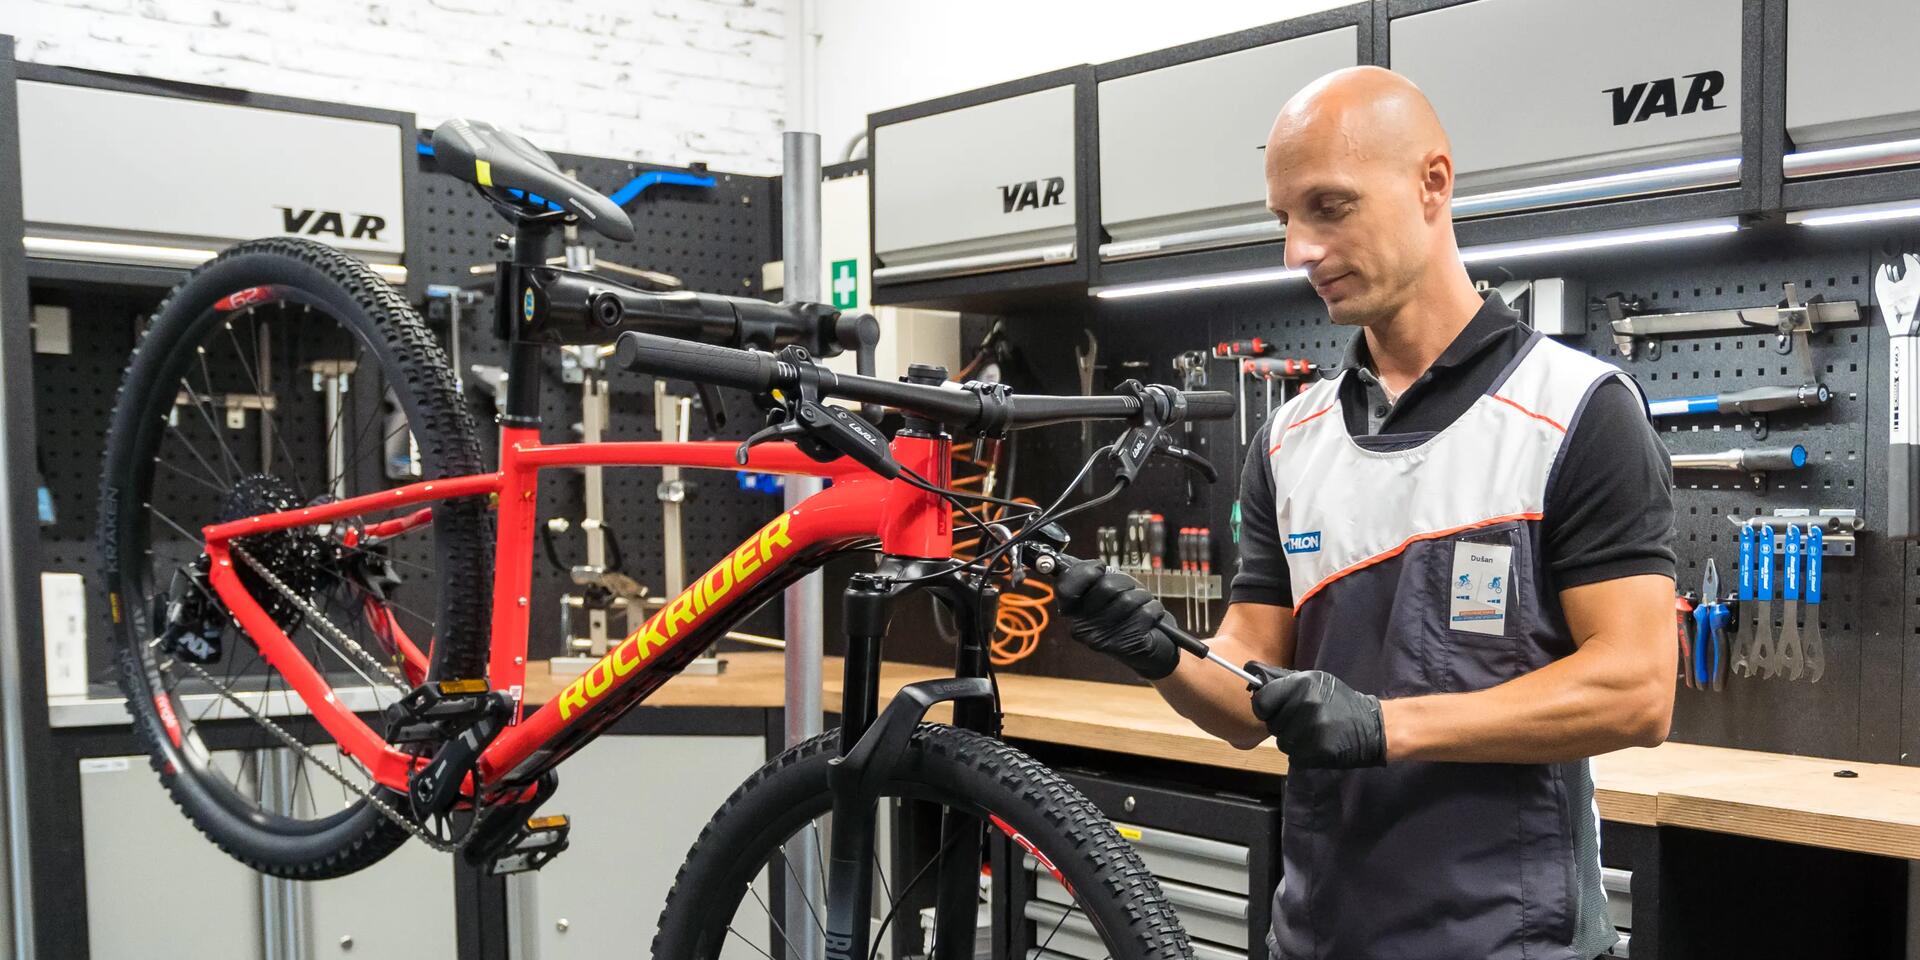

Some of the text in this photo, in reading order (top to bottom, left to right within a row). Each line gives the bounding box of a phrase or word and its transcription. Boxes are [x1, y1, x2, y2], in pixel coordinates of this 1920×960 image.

[1602, 70, 1727, 126] VAR
[273, 204, 389, 242] VAR
[996, 176, 1066, 214] VAR
[105, 486, 119, 573] KRAKEN
[559, 513, 793, 721] ROCKRIDER
